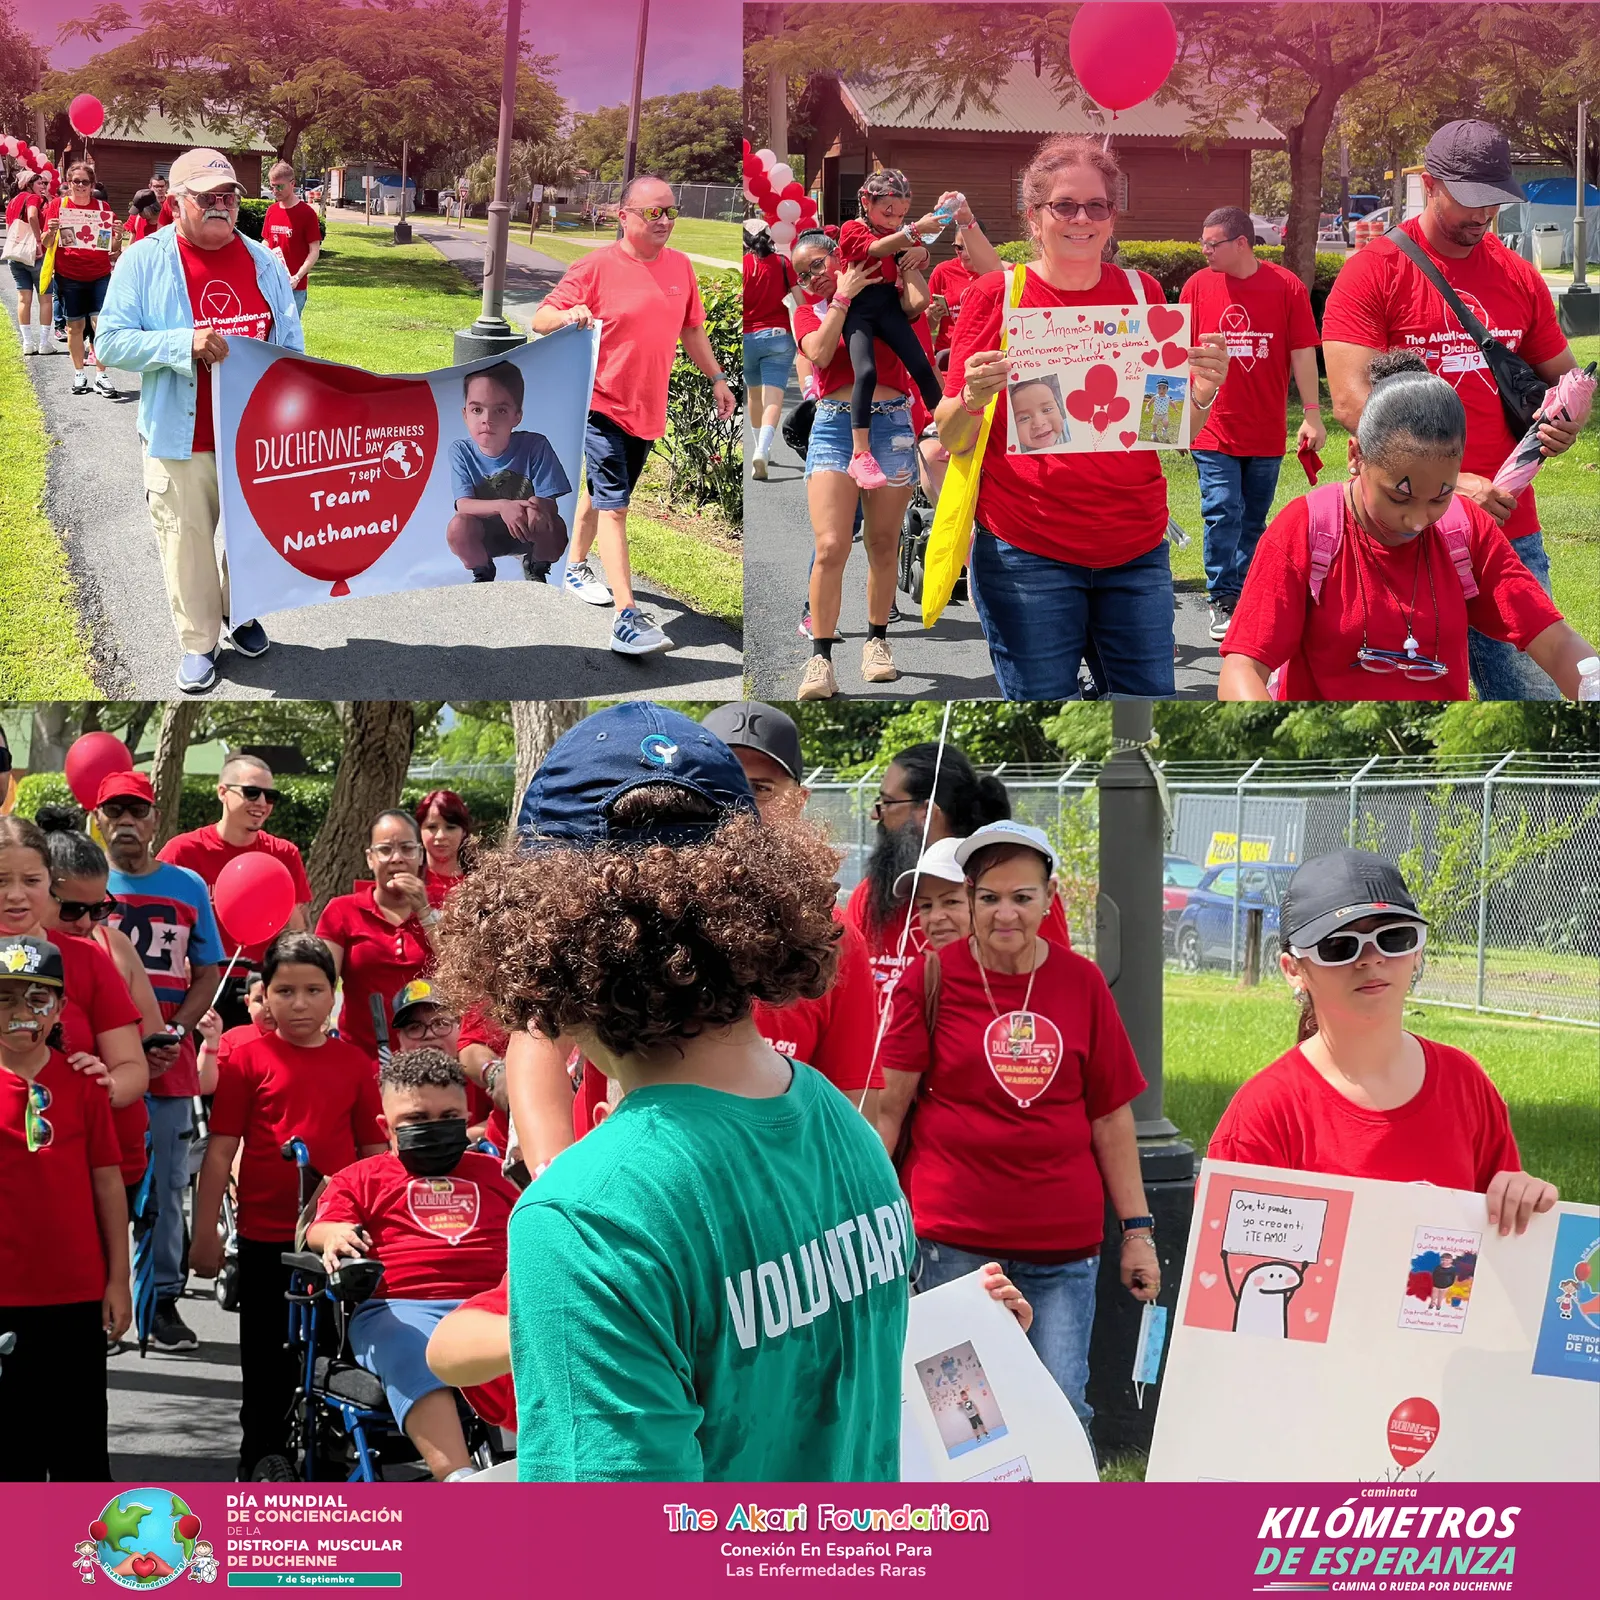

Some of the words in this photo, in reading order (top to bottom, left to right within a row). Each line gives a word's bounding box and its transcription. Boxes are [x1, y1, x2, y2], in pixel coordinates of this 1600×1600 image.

[212, 311, 272, 325] Foundation.org
[215, 325, 249, 335] chenne
[1009, 312, 1038, 340] Te
[1094, 320, 1140, 335] NOAH
[1405, 334, 1426, 345] The
[1429, 332, 1456, 343] Akari
[1124, 361, 1132, 373] 2
[365, 425, 425, 440] AWARENESS
[255, 426, 362, 472] DUCHENNE
[365, 441, 384, 454] DAY
[349, 472, 357, 484] 7
[358, 467, 381, 483] sept
[310, 489, 370, 511] Team
[283, 513, 398, 554] Nathanael
[995, 1064, 1039, 1074] GRANDMA
[1041, 1066, 1053, 1074] OF
[1003, 1075, 1044, 1085] WARRIOR
[1267, 1206, 1292, 1214] puedes
[1565, 1341, 1582, 1352] DE
